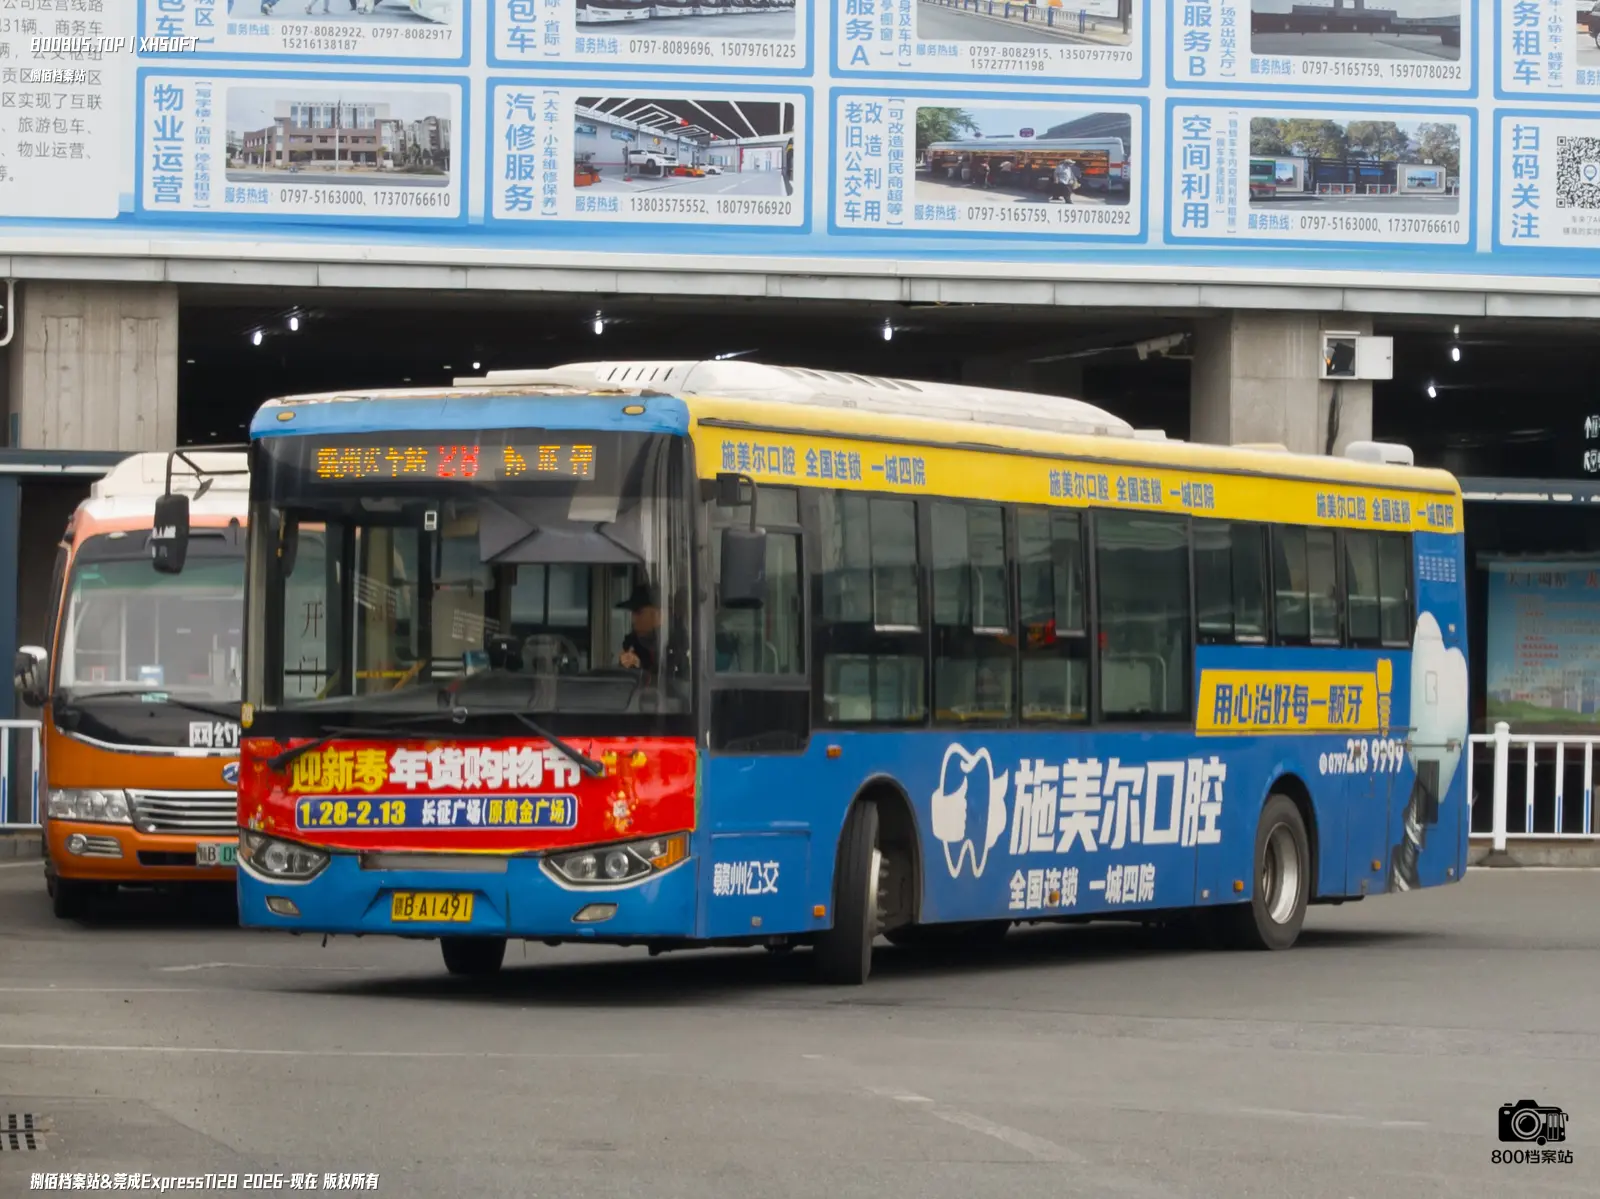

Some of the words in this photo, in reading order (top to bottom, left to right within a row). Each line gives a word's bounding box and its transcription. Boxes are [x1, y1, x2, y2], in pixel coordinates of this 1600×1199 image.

[282, 38, 358, 50] 15216138187
[1183, 0, 1213, 77] 服务B
[971, 59, 1045, 71] 15727771198
[1576, 69, 1600, 86] 服务
[152, 83, 184, 203] 物业运营
[505, 93, 536, 212] 汽修服务
[844, 102, 863, 222] 老旧公交车
[864, 102, 883, 222] 改造利用
[1182, 115, 1211, 229] 空间利用
[1512, 124, 1540, 238] 扫码关注
[721, 440, 796, 476] 施美尔口腔
[805, 448, 862, 481] 全国连锁
[871, 454, 926, 485] 一城四院
[1049, 469, 1109, 501] 施美尔口腔
[1116, 475, 1163, 504] 全国连锁
[1169, 481, 1215, 509] 一城四院
[1316, 492, 1367, 521] 施美尔口腔
[1372, 497, 1411, 524] 全国连锁
[1417, 501, 1454, 528] 一城四院
[1213, 684, 1363, 725] 用心治好每一颗牙
[189, 721, 241, 748] 网约
[300, 801, 406, 825] 1.28-2.13
[1009, 756, 1227, 856] 施美尔口腔
[713, 860, 779, 896] 赣州公交
[1008, 866, 1079, 910] 全国连锁
[1089, 863, 1156, 904] 一城四院
